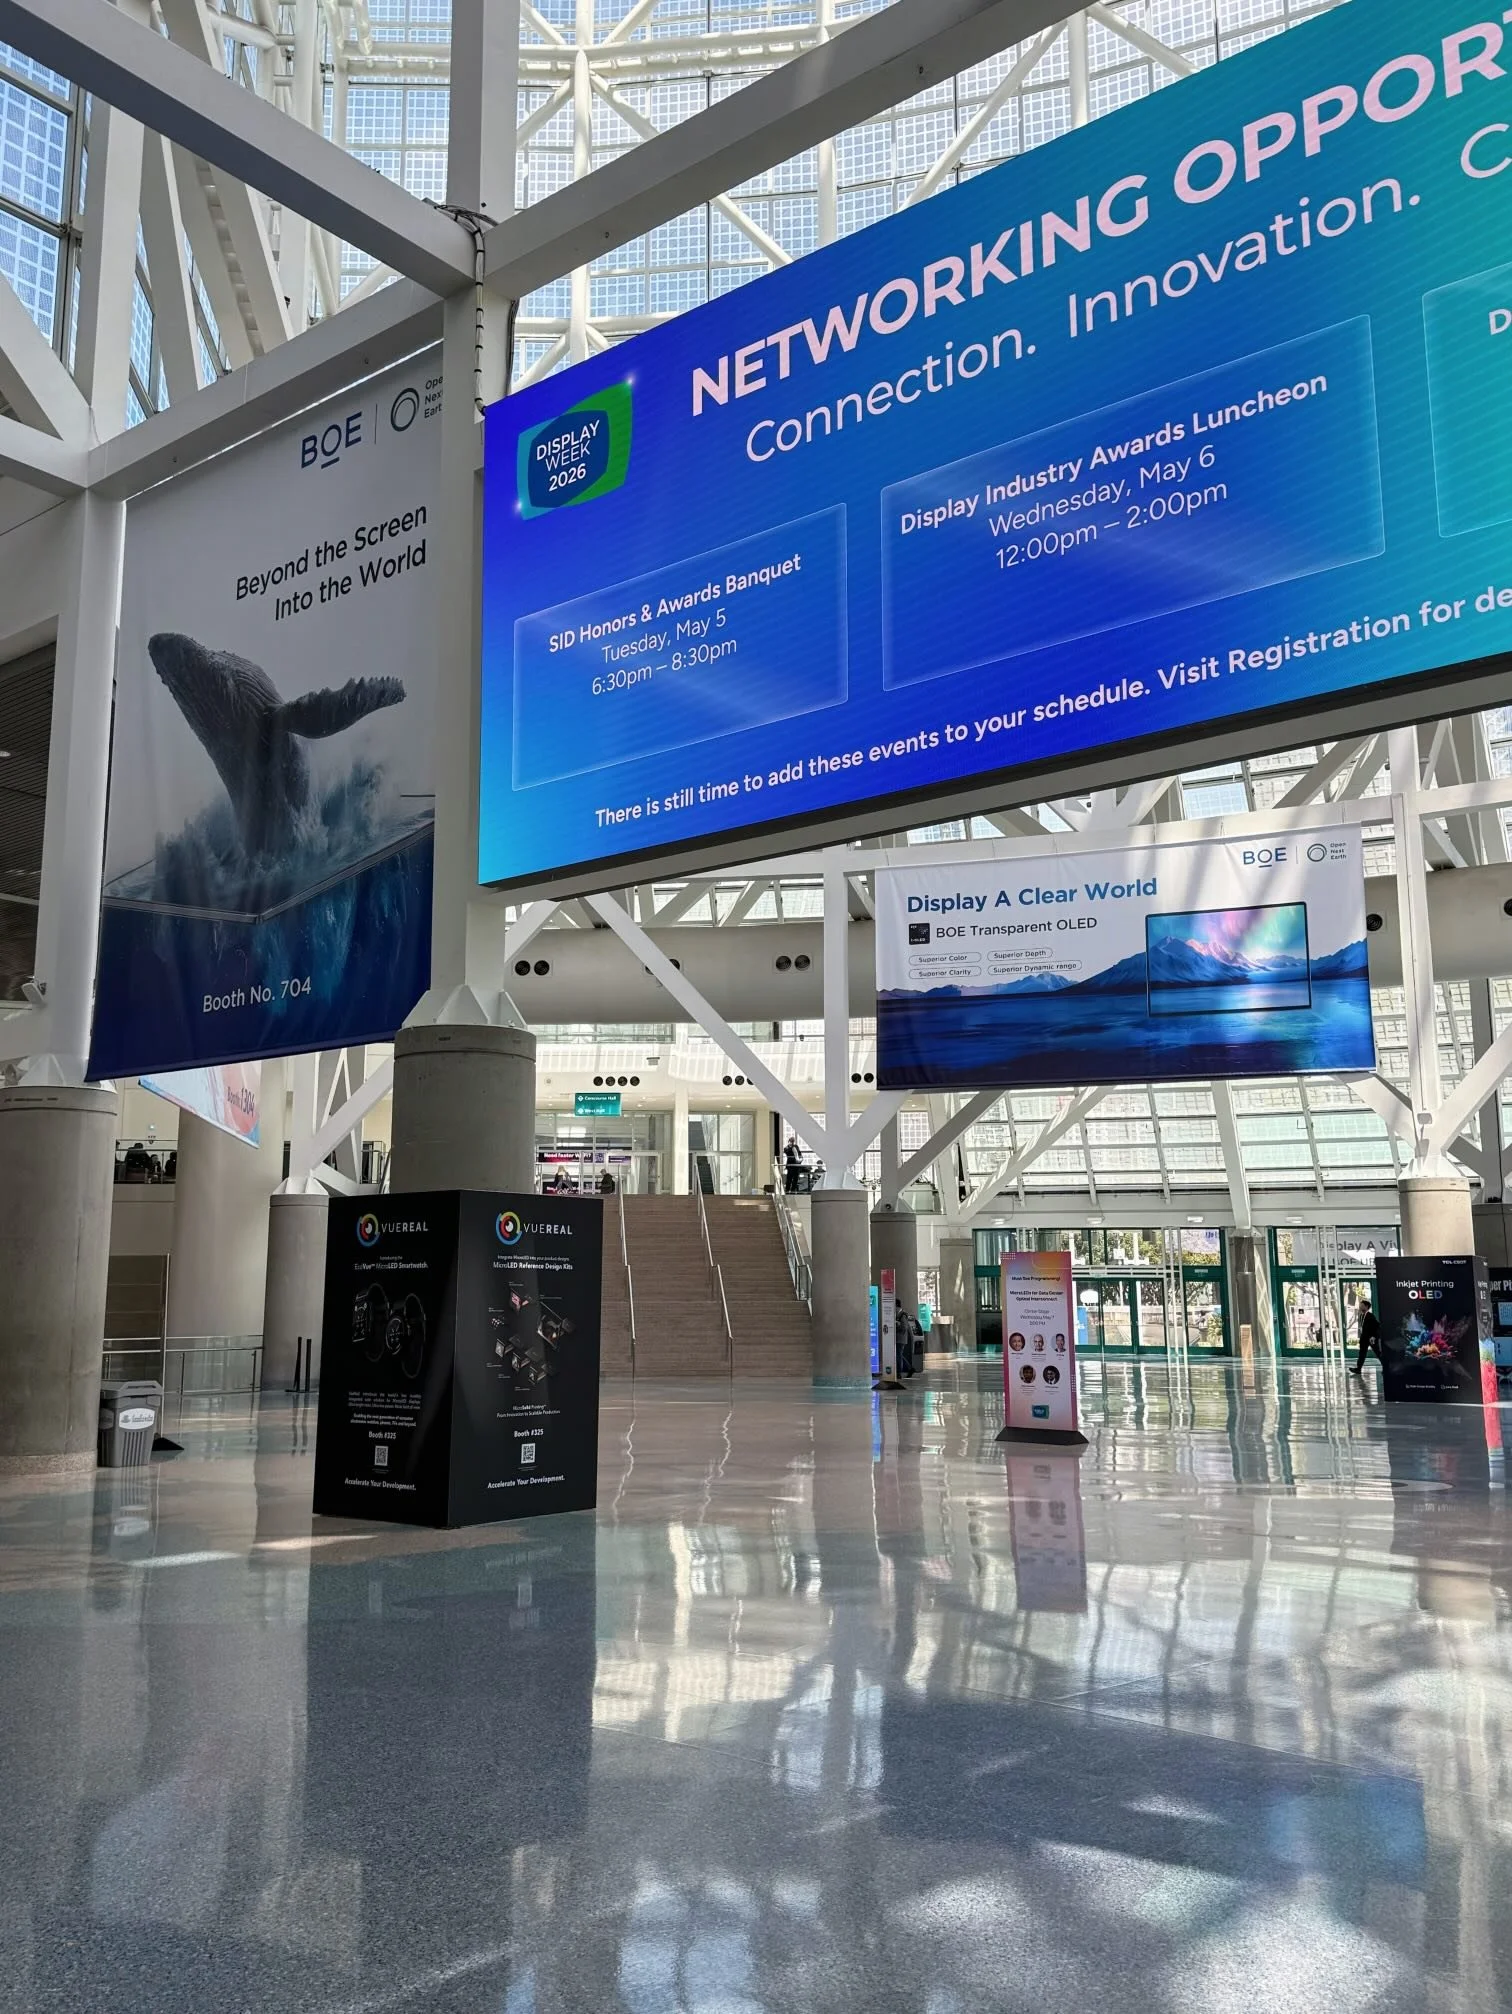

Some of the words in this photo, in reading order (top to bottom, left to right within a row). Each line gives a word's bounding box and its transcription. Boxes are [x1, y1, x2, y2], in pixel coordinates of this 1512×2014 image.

[691, 174, 1149, 417] NETWORKING
[746, 326, 1036, 462] Connection.
[1068, 178, 1421, 339] Innovation.
[301, 411, 362, 469] BOE
[536, 420, 600, 461] DISPLAY
[545, 440, 591, 472] WEEK
[901, 490, 978, 534] Display
[985, 457, 1083, 506] Industry
[1090, 420, 1185, 470] Awards
[1192, 374, 1327, 434] Luncheon
[548, 463, 587, 492] 2026
[988, 478, 1131, 537] Wednesday,
[1139, 459, 1191, 489] May
[1198, 445, 1215, 468] 6
[995, 522, 1097, 569] 12:00pm
[1126, 480, 1228, 531] 2:00pm
[236, 549, 309, 600] Beyond
[315, 539, 348, 568] the
[354, 505, 427, 551] Screen
[275, 591, 313, 621] Into
[319, 574, 352, 603] the
[359, 539, 426, 587] World
[549, 630, 575, 653] SID
[579, 612, 637, 642] Honors
[640, 604, 652, 622] &
[656, 581, 721, 618] Awards
[726, 553, 801, 594] Banquet
[601, 628, 671, 664] Tuesday,
[676, 616, 711, 642] May
[716, 608, 726, 627] 5
[592, 664, 652, 695] 6:30pm
[671, 637, 737, 671] 8:30pm
[595, 806, 642, 829] There
[646, 797, 660, 816] is
[664, 786, 694, 812] still
[698, 780, 739, 804] time
[744, 773, 763, 793] to
[768, 760, 803, 786] add
[808, 749, 863, 777] these
[868, 729, 939, 763] events
[945, 722, 968, 742] to
[973, 709, 1027, 741] your
[1033, 674, 1150, 722] schedule.
[1157, 655, 1219, 690] Visit
[1228, 612, 1410, 674] Registration
[1418, 598, 1467, 627] for
[1243, 847, 1287, 868] BOE
[907, 893, 987, 914] Display
[994, 890, 1011, 908] A
[1018, 887, 1077, 906] Clear
[1084, 877, 1157, 901] World
[936, 926, 966, 938] BOE
[971, 919, 1052, 938] Transparent
[1056, 917, 1097, 932] OLED
[993, 951, 1023, 959] Superior
[1025, 949, 1046, 957] Depth
[993, 965, 1022, 973] Superior
[1024, 964, 1054, 972] Dynamic
[203, 988, 245, 1013] Booth
[250, 985, 276, 1005] No.
[280, 976, 312, 999] 704
[381, 1221, 429, 1233] VUEREAL
[523, 1223, 573, 1235] VUEREAL
[518, 1262, 544, 1270] Reference
[545, 1262, 563, 1271] Design
[1396, 1280, 1419, 1289] Inkjet
[1421, 1280, 1454, 1289] Printing
[1408, 1290, 1443, 1300] OLED
[368, 1430, 383, 1438] Booth
[384, 1431, 397, 1439] #325
[514, 1429, 530, 1438] Booth
[531, 1428, 544, 1436] #325
[344, 1477, 369, 1487] Accelerate
[370, 1479, 381, 1487] Your
[382, 1481, 416, 1491] Development.
[487, 1479, 516, 1489] Accelerate
[516, 1478, 529, 1486] Your
[529, 1474, 565, 1484] Development.
